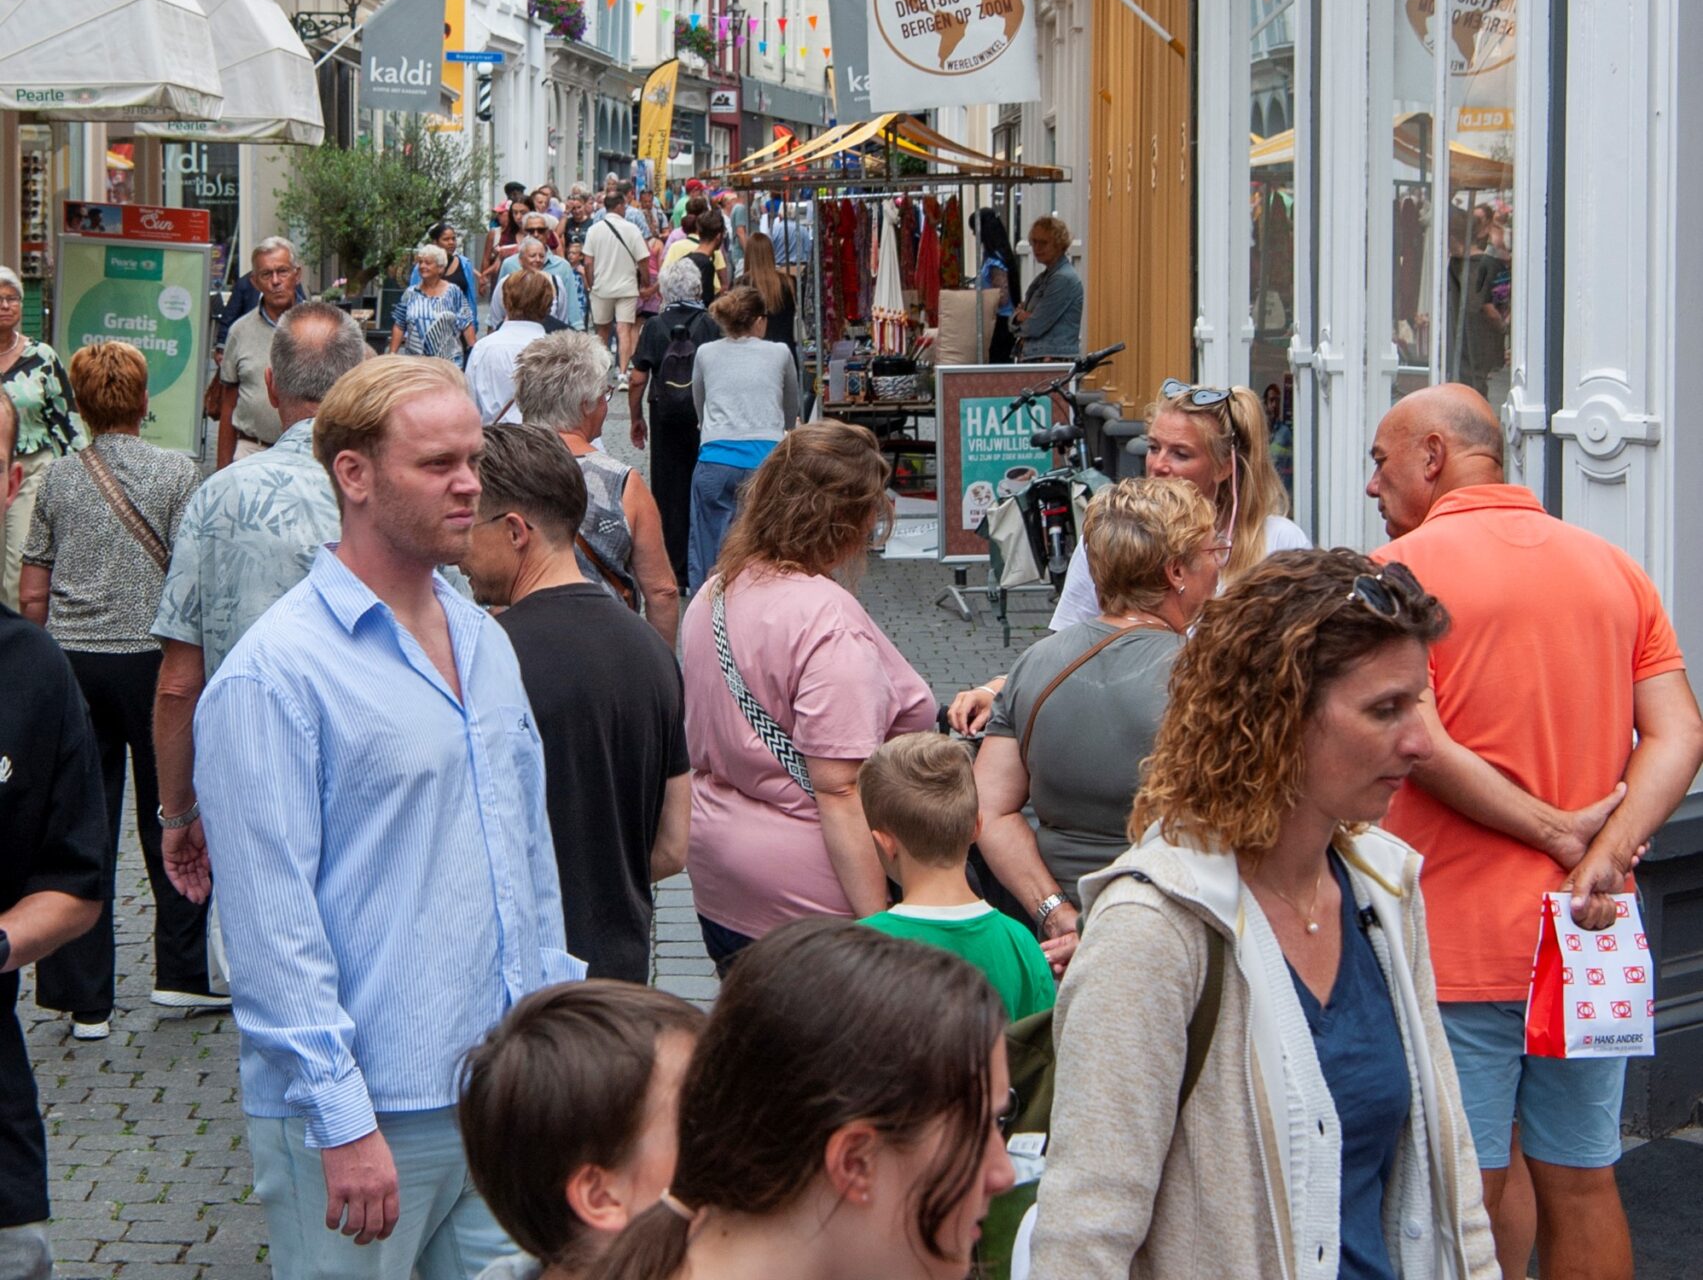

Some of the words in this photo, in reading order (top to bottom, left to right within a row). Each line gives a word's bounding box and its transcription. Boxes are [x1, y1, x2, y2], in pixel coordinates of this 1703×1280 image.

[901, 12, 953, 39] BERGEN
[954, 7, 972, 25] OP
[947, 40, 1006, 70] WERELDWINKEL
[370, 56, 432, 86] kaldi
[16, 88, 65, 102] Pearle
[168, 120, 207, 130] Pearle
[111, 257, 138, 267] Pearle
[104, 313, 157, 332] Gratis
[966, 404, 1047, 437] HALLO
[1595, 1034, 1615, 1044] HANS
[1616, 1033, 1644, 1043] ANDERS
